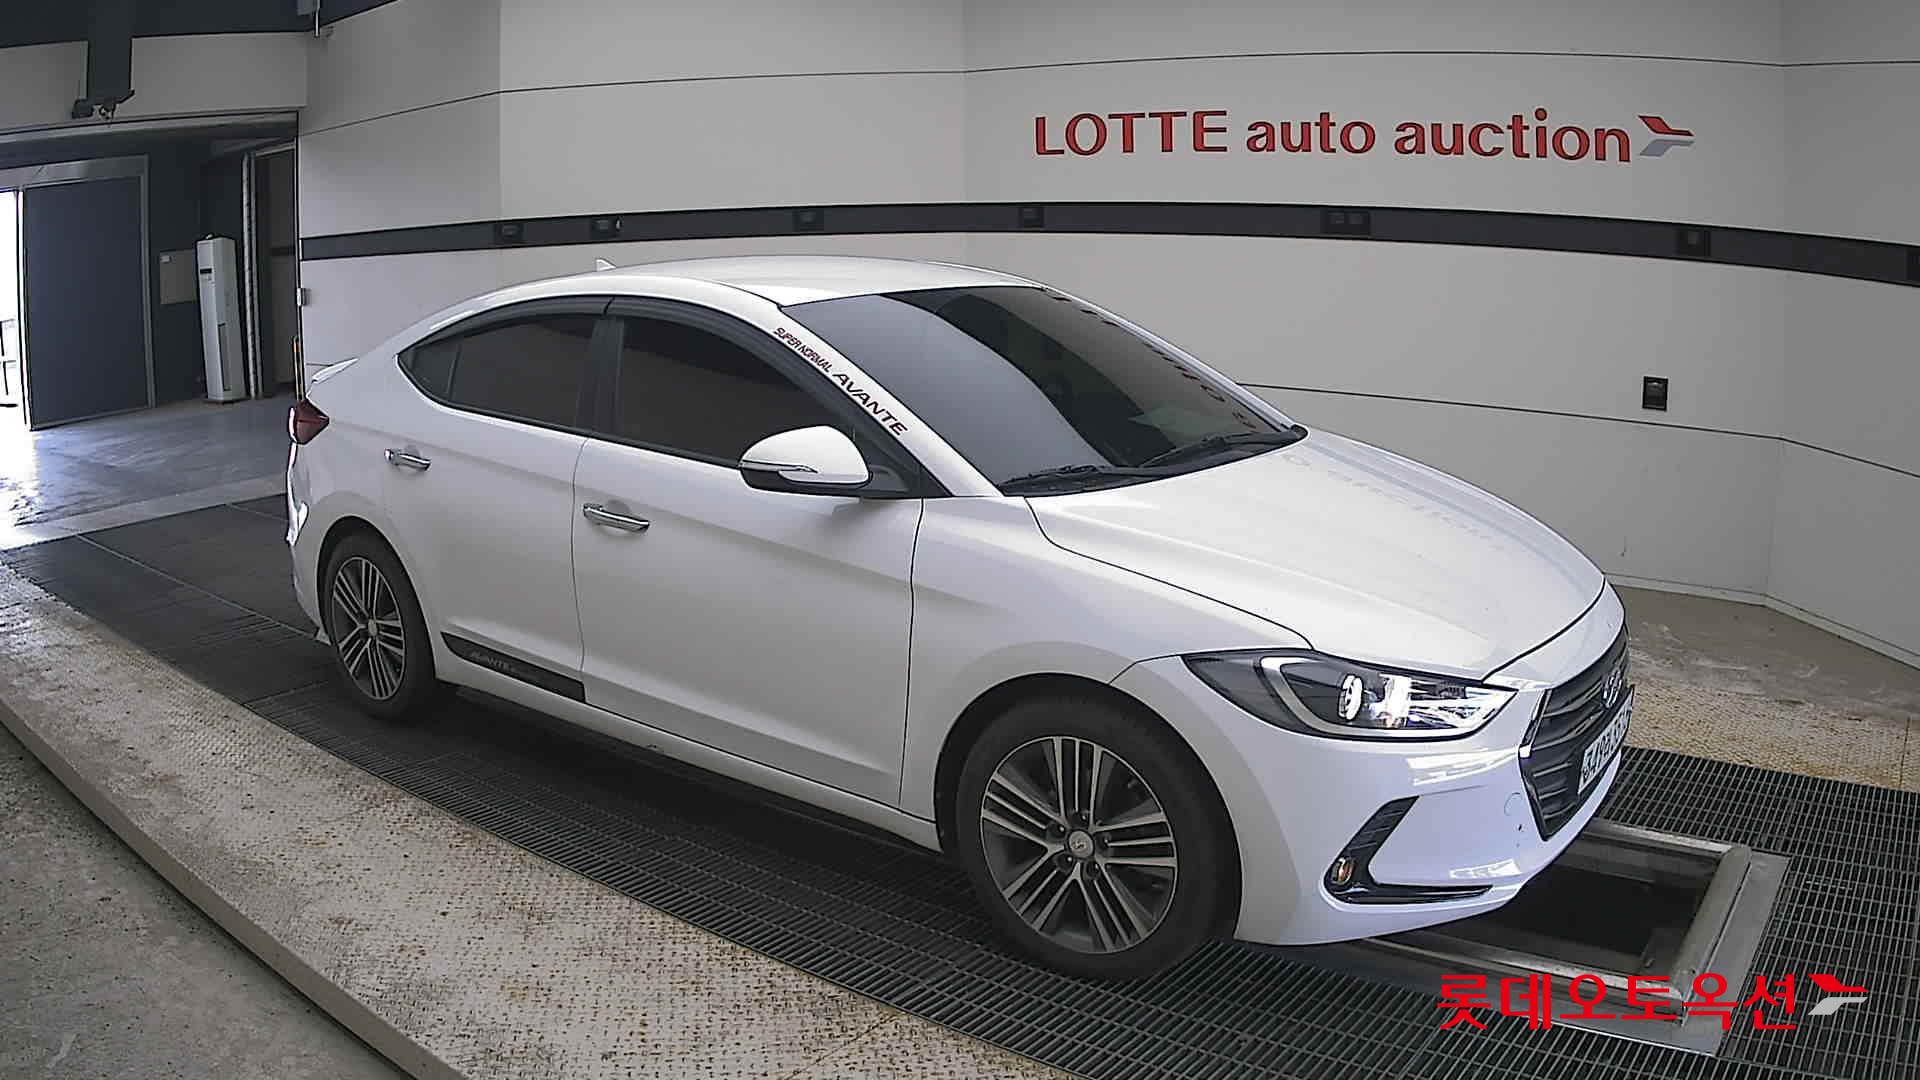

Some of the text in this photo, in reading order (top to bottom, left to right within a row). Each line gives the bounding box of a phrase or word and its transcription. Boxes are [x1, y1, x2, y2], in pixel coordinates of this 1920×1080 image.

[1036, 108, 1631, 162] LOTTE auto auction
[832, 373, 908, 436] AVANTE
[470, 650, 511, 673] ANTE
